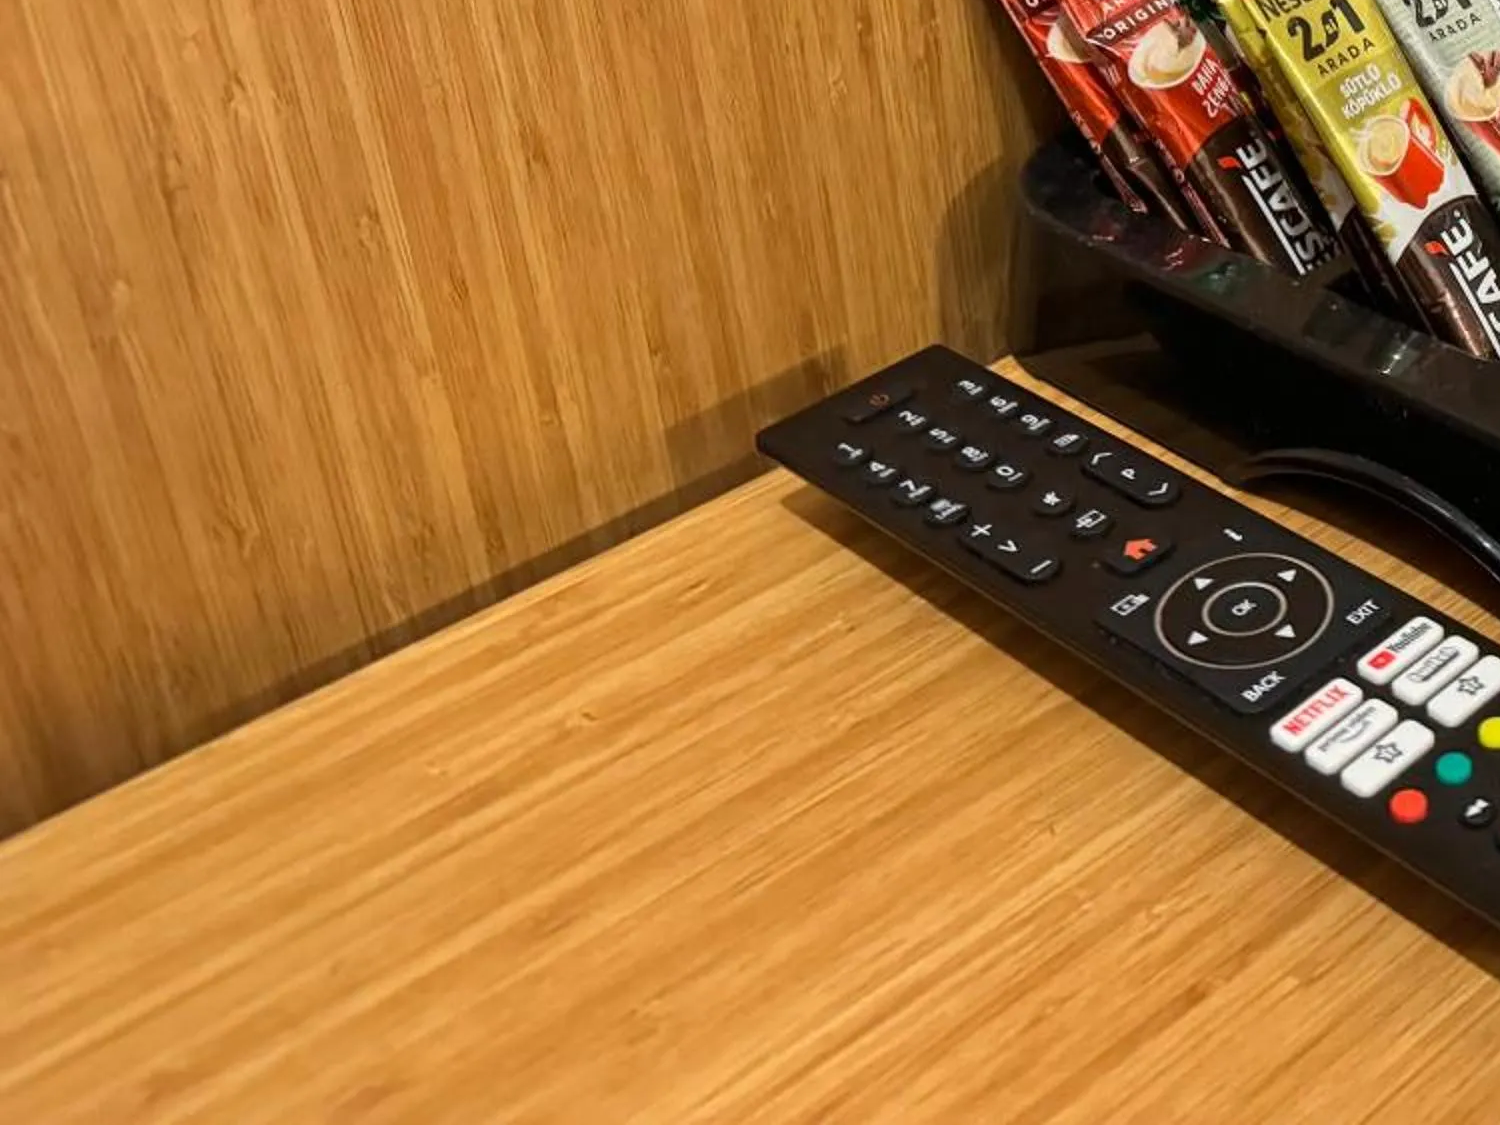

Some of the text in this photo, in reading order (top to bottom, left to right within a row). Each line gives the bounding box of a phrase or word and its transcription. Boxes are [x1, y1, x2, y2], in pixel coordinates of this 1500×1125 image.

[1427, 13, 1481, 42] ARADA
[1316, 37, 1375, 76] ARADA
[1231, 599, 1257, 616] OK
[1345, 599, 1381, 624] EXIT
[1240, 670, 1286, 702] BACK
[1282, 685, 1350, 736] NETFLIX
